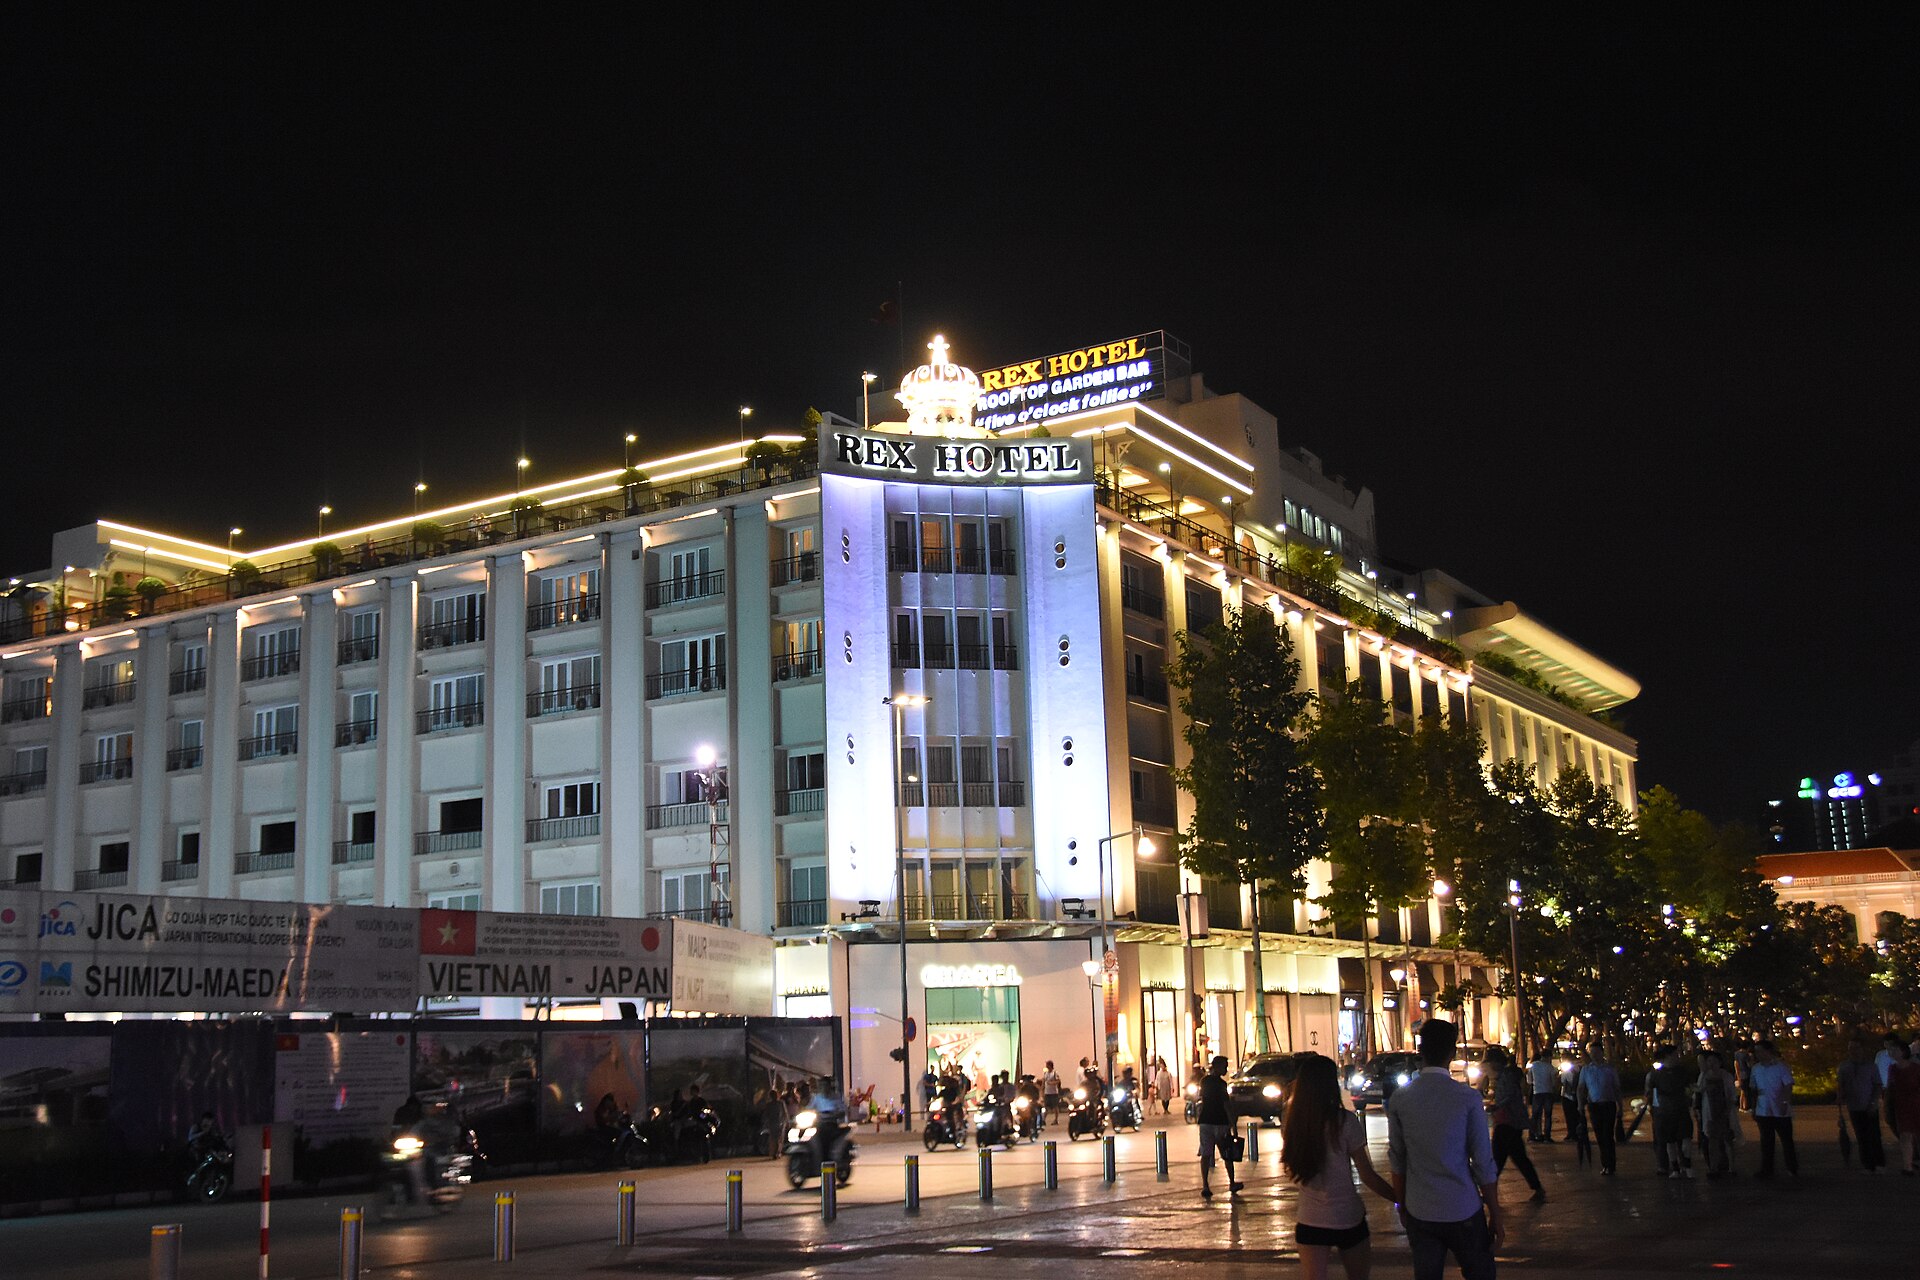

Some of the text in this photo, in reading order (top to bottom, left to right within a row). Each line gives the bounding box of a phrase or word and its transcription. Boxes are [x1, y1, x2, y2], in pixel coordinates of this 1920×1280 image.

[982, 338, 1147, 392] REX HOTEL
[1051, 368, 1115, 395] GARDEN
[1116, 361, 1151, 382] BAR
[834, 432, 1081, 478] REX HOTEL
[87, 902, 160, 941] JICA
[181, 911, 207, 926] QUAN
[164, 930, 192, 943] JAPAN
[193, 930, 258, 945] INTERNATIONAL
[84, 964, 291, 999] SHIMIZU-MAEDA
[428, 961, 551, 994] VIETNAM
[565, 976, 573, 984] -
[585, 965, 668, 995] JAPAN
